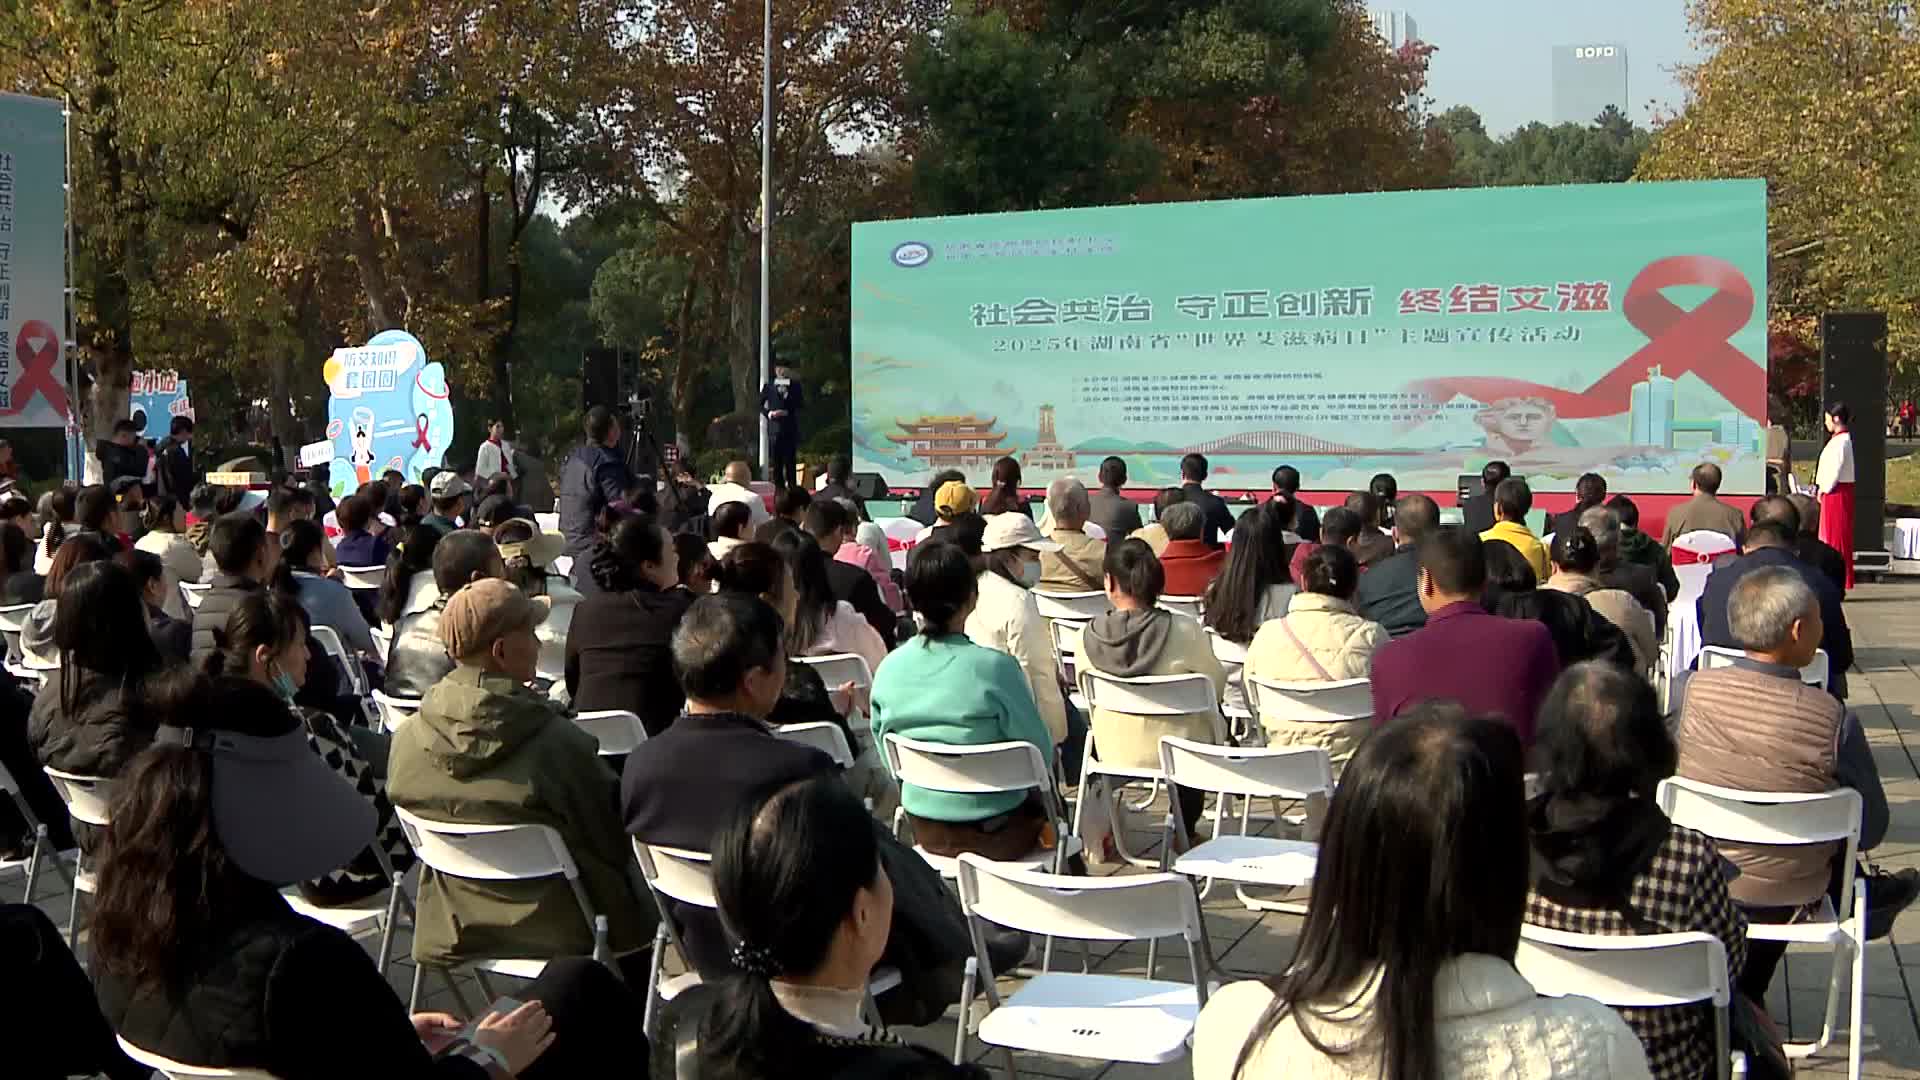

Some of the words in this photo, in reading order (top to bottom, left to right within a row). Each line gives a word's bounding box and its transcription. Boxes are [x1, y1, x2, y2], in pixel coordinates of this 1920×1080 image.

[971, 295, 1152, 326] 社会共治
[1176, 287, 1372, 321] 守正创新
[1399, 281, 1611, 315] 终结艾滋
